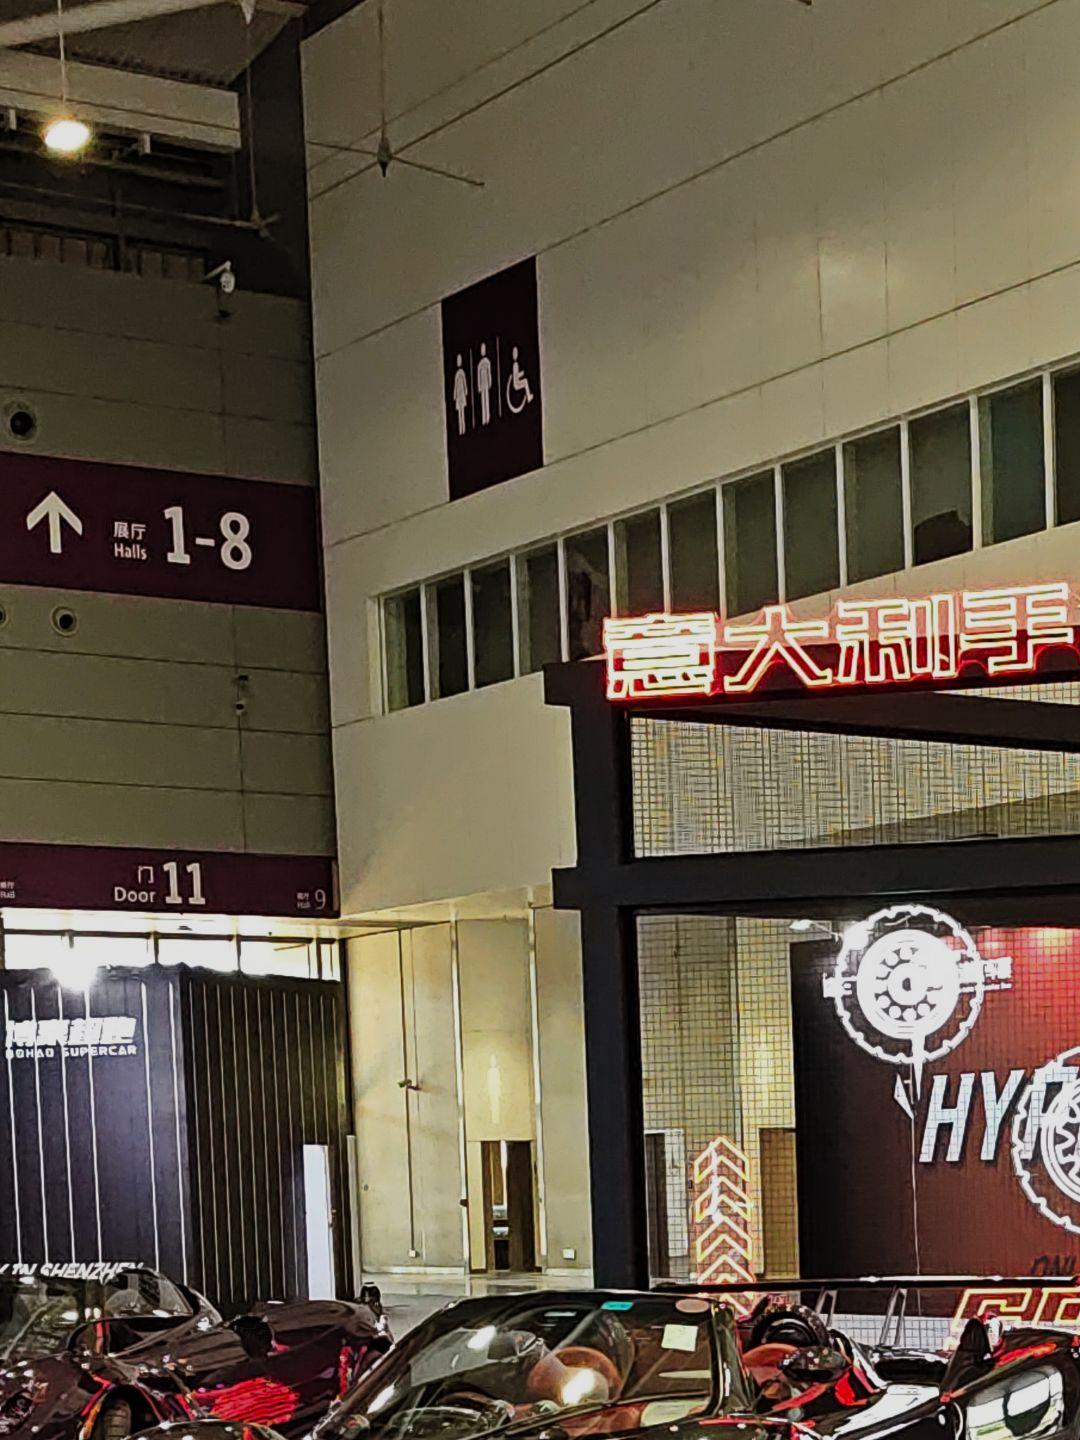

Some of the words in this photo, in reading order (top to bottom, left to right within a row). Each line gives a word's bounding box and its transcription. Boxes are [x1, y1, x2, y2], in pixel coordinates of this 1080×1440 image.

[114, 521, 147, 541] 展厅
[163, 506, 253, 571] 1-8
[114, 543, 148, 561] Halls
[138, 865, 155, 885] 门
[162, 861, 206, 906] 11
[114, 886, 156, 904] Door
[314, 889, 327, 911] 9
[62, 1044, 138, 1058] SUPERCAR
[40, 1262, 145, 1281] SHENZH
